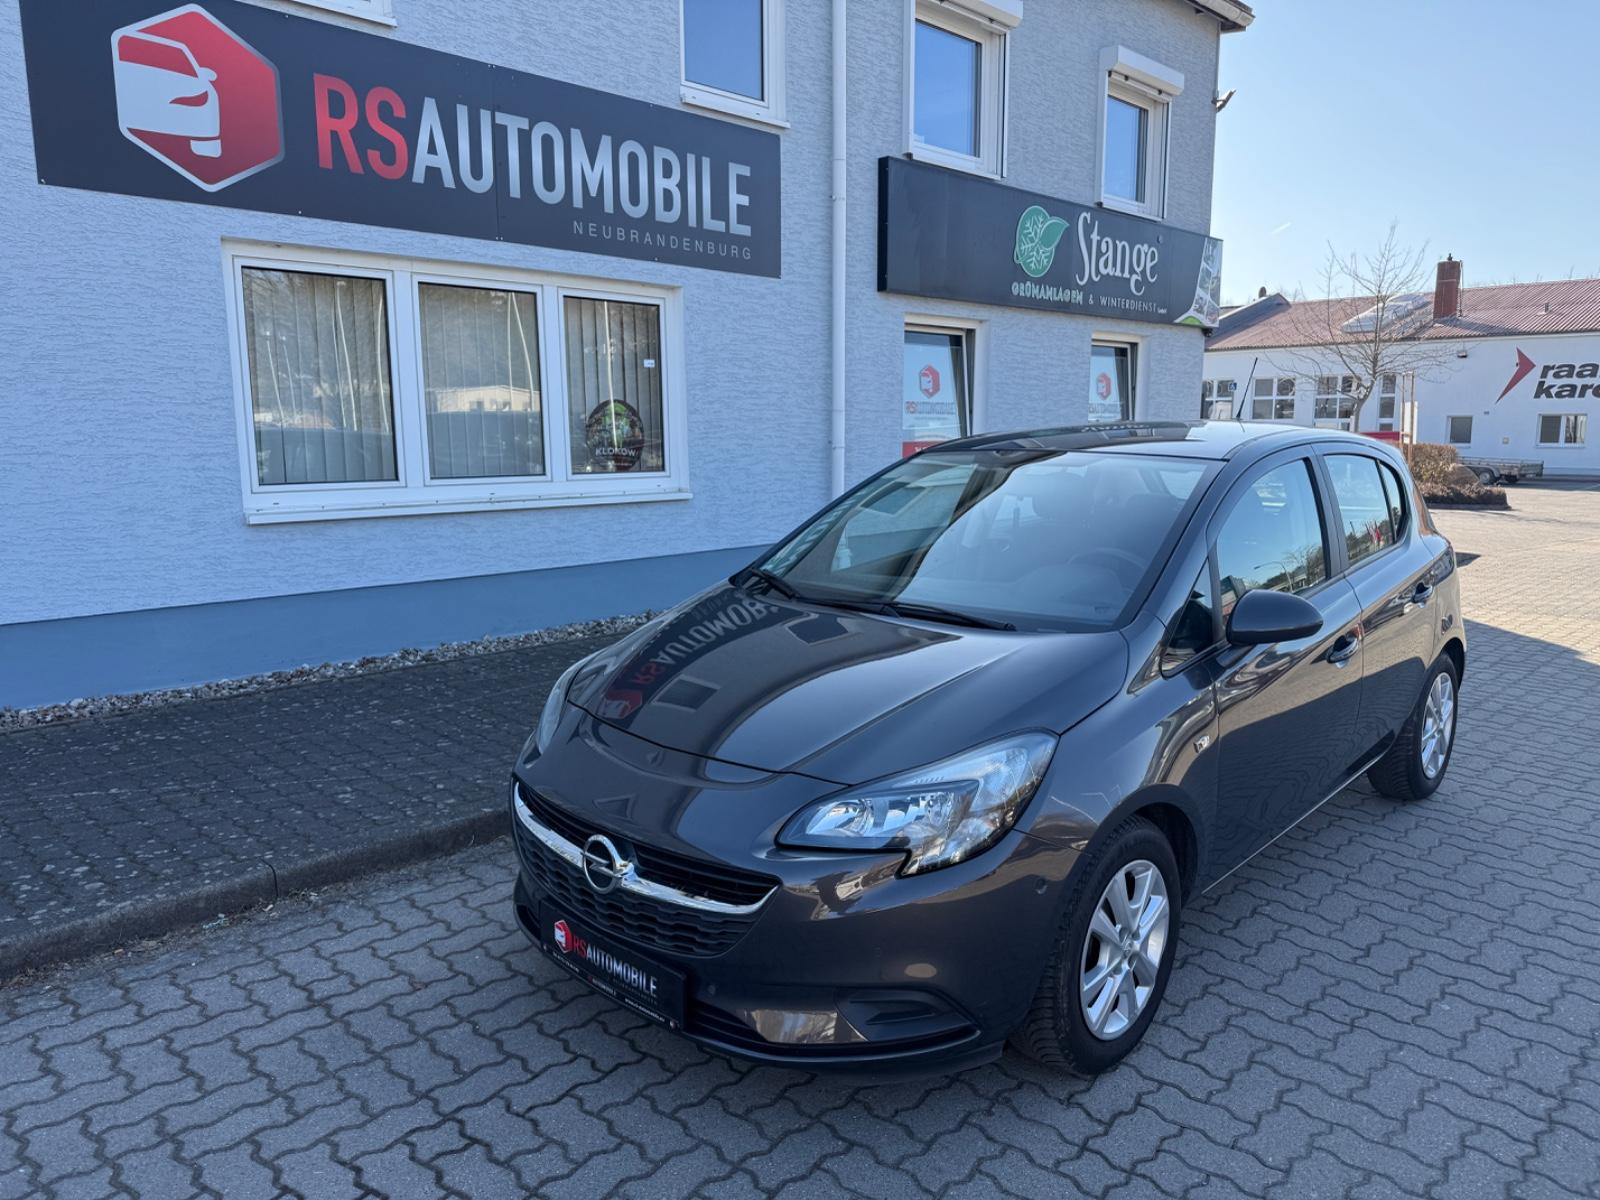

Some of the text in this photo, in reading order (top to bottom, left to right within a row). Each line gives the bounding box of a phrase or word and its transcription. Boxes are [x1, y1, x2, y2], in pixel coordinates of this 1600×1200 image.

[573, 220, 752, 260] NEUBRANDENBURG
[1075, 211, 1159, 296] Stange
[1011, 280, 1084, 306] GRÜNANLAGEN
[1088, 293, 1095, 306] &
[1100, 295, 1157, 314] WINTERDIENST
[1540, 362, 1600, 380] raa
